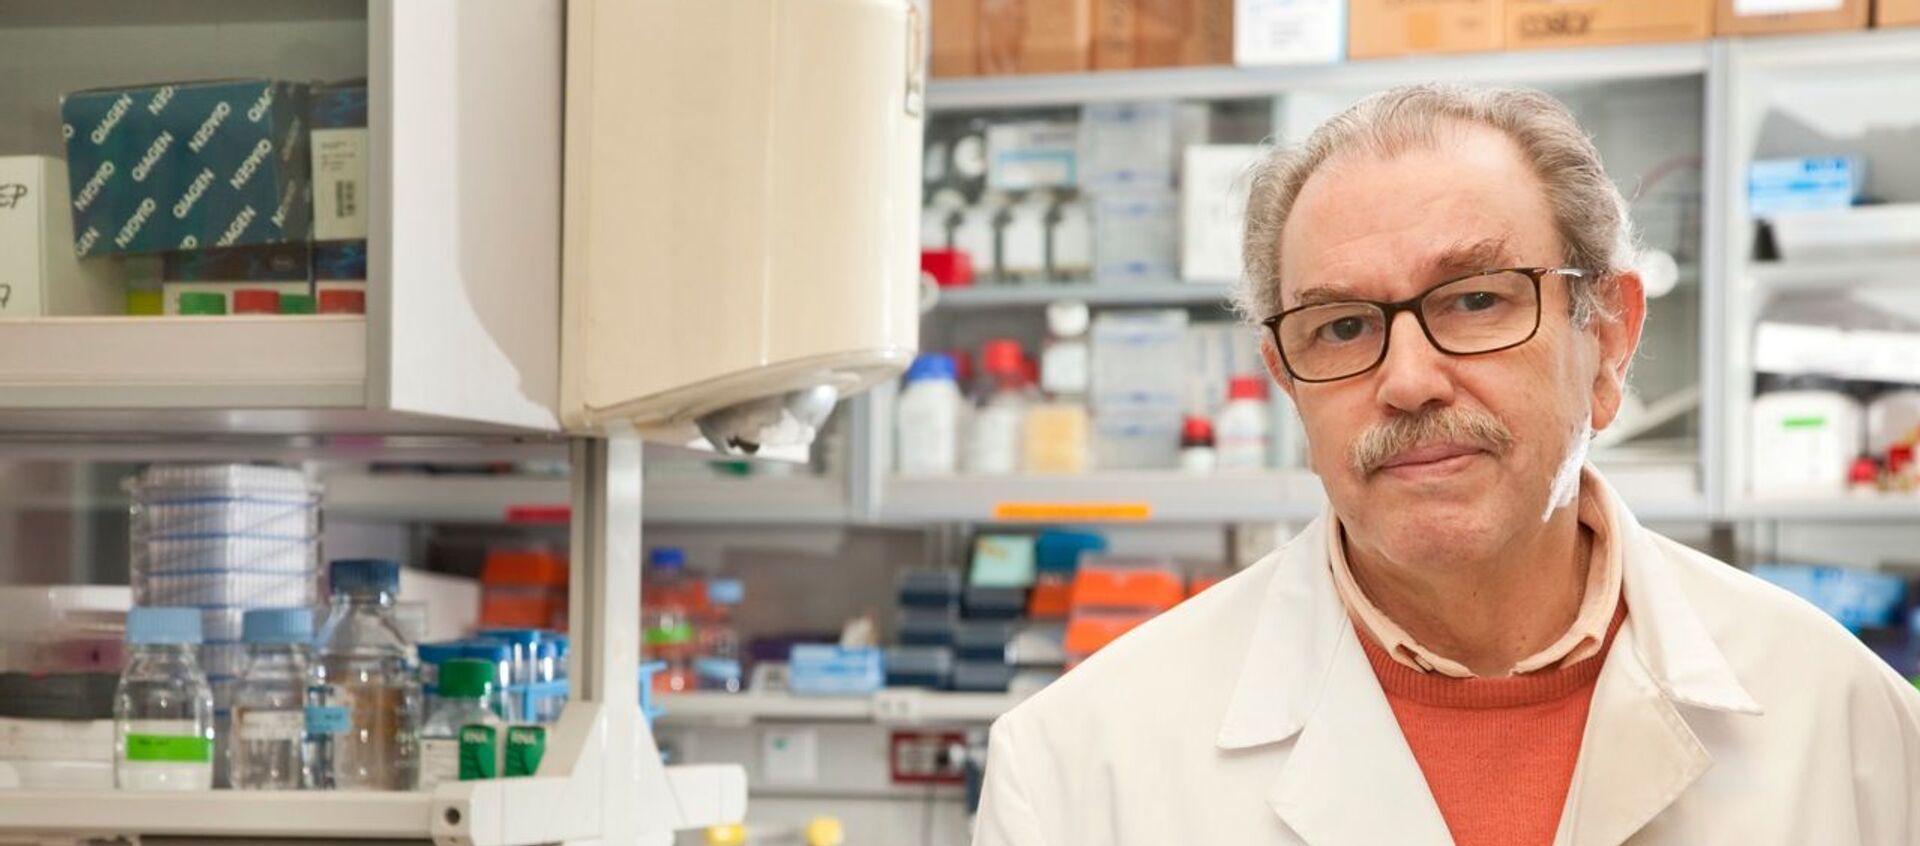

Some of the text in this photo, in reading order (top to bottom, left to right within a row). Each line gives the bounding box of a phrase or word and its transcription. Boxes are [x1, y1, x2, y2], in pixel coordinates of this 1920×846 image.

[91, 93, 132, 144] QIAGEN
[148, 86, 173, 115] GEN
[188, 101, 230, 152] QIAGEN
[132, 131, 173, 181] QIAGEN
[230, 138, 271, 189] QIAGEN
[74, 161, 114, 211] QIAGEN
[174, 167, 214, 218] QIAGEN
[75, 226, 99, 256] GEN
[115, 198, 155, 249] QIAGEN
